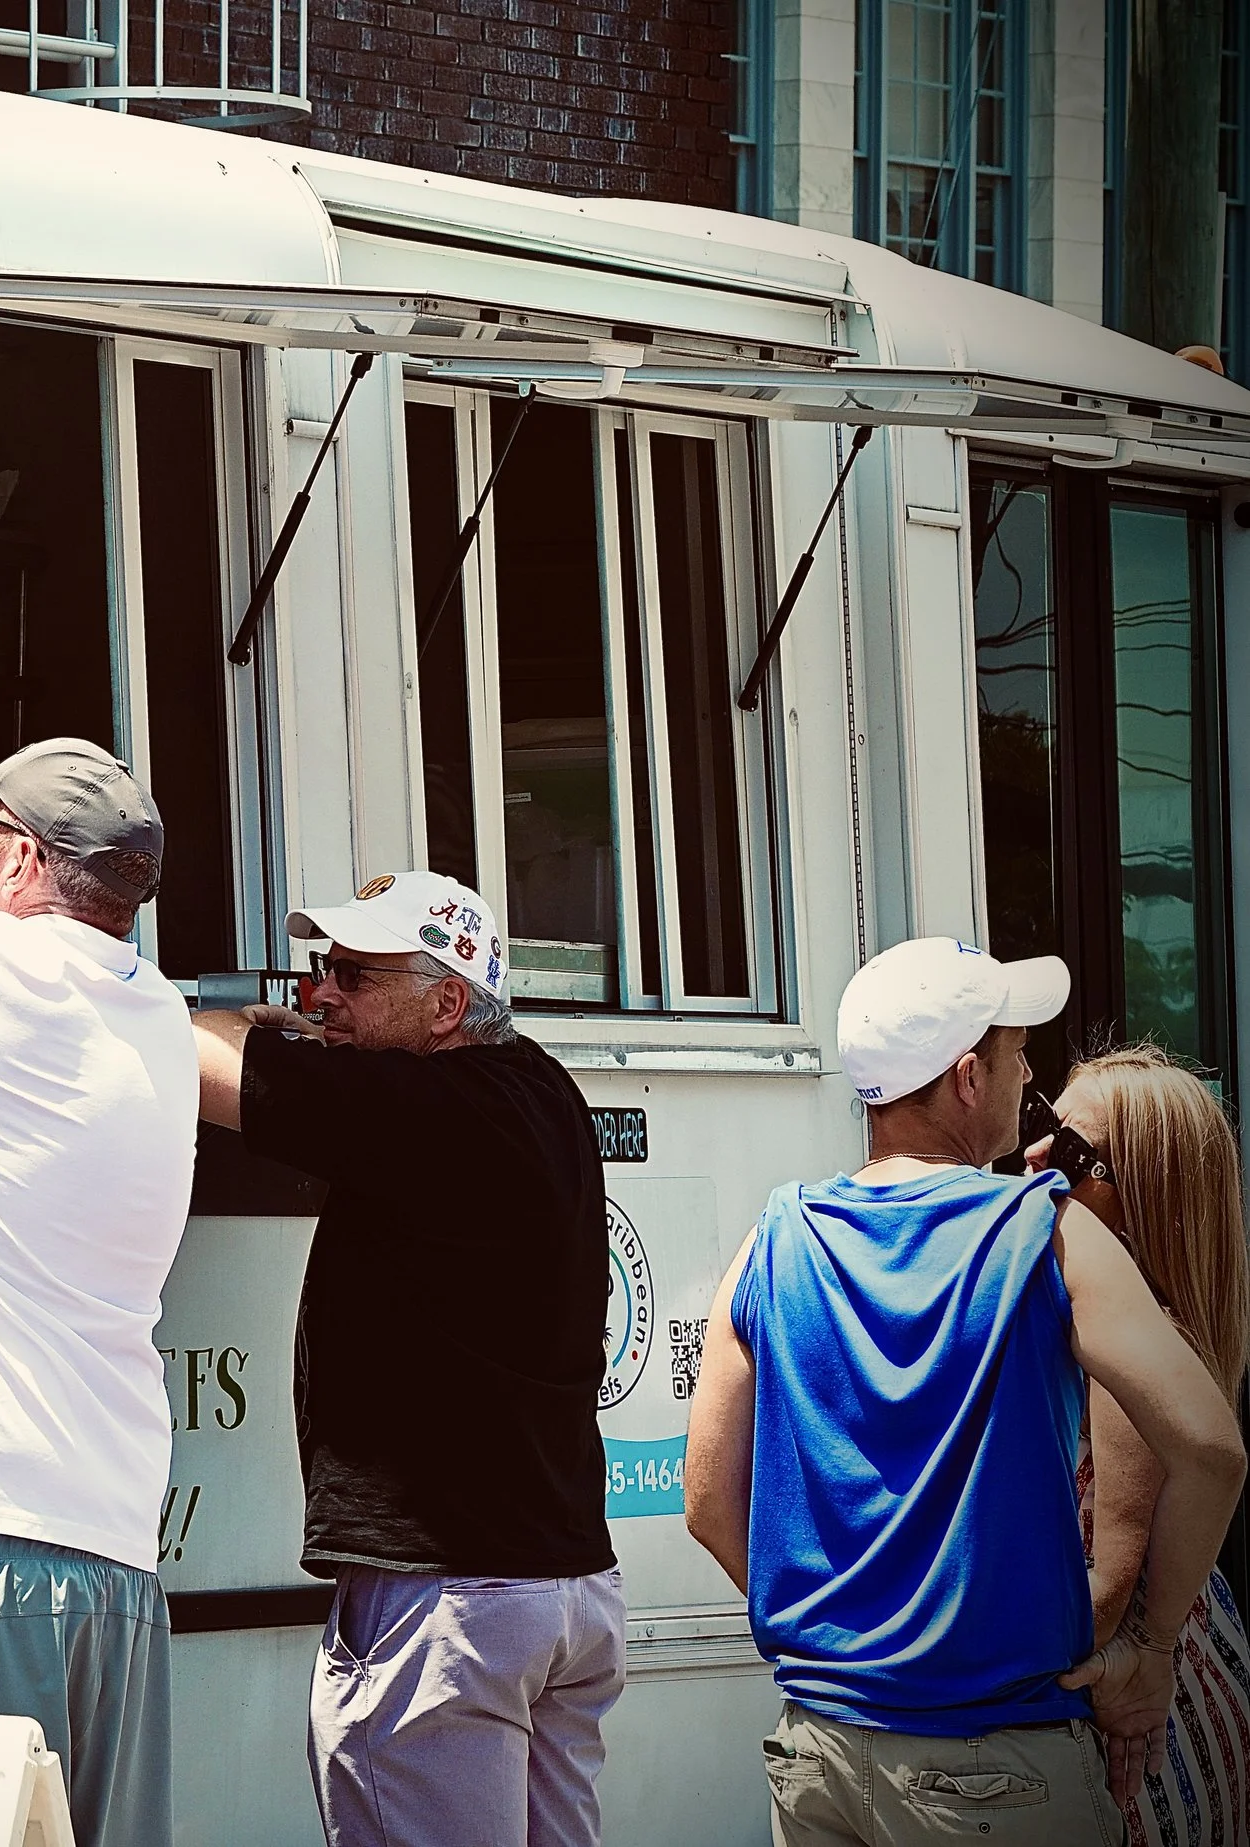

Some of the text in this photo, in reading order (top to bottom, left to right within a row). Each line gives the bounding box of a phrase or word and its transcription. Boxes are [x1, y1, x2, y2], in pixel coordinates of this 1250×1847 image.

[592, 1112, 644, 1157] DER HERE
[606, 1212, 647, 1344] aribbean
